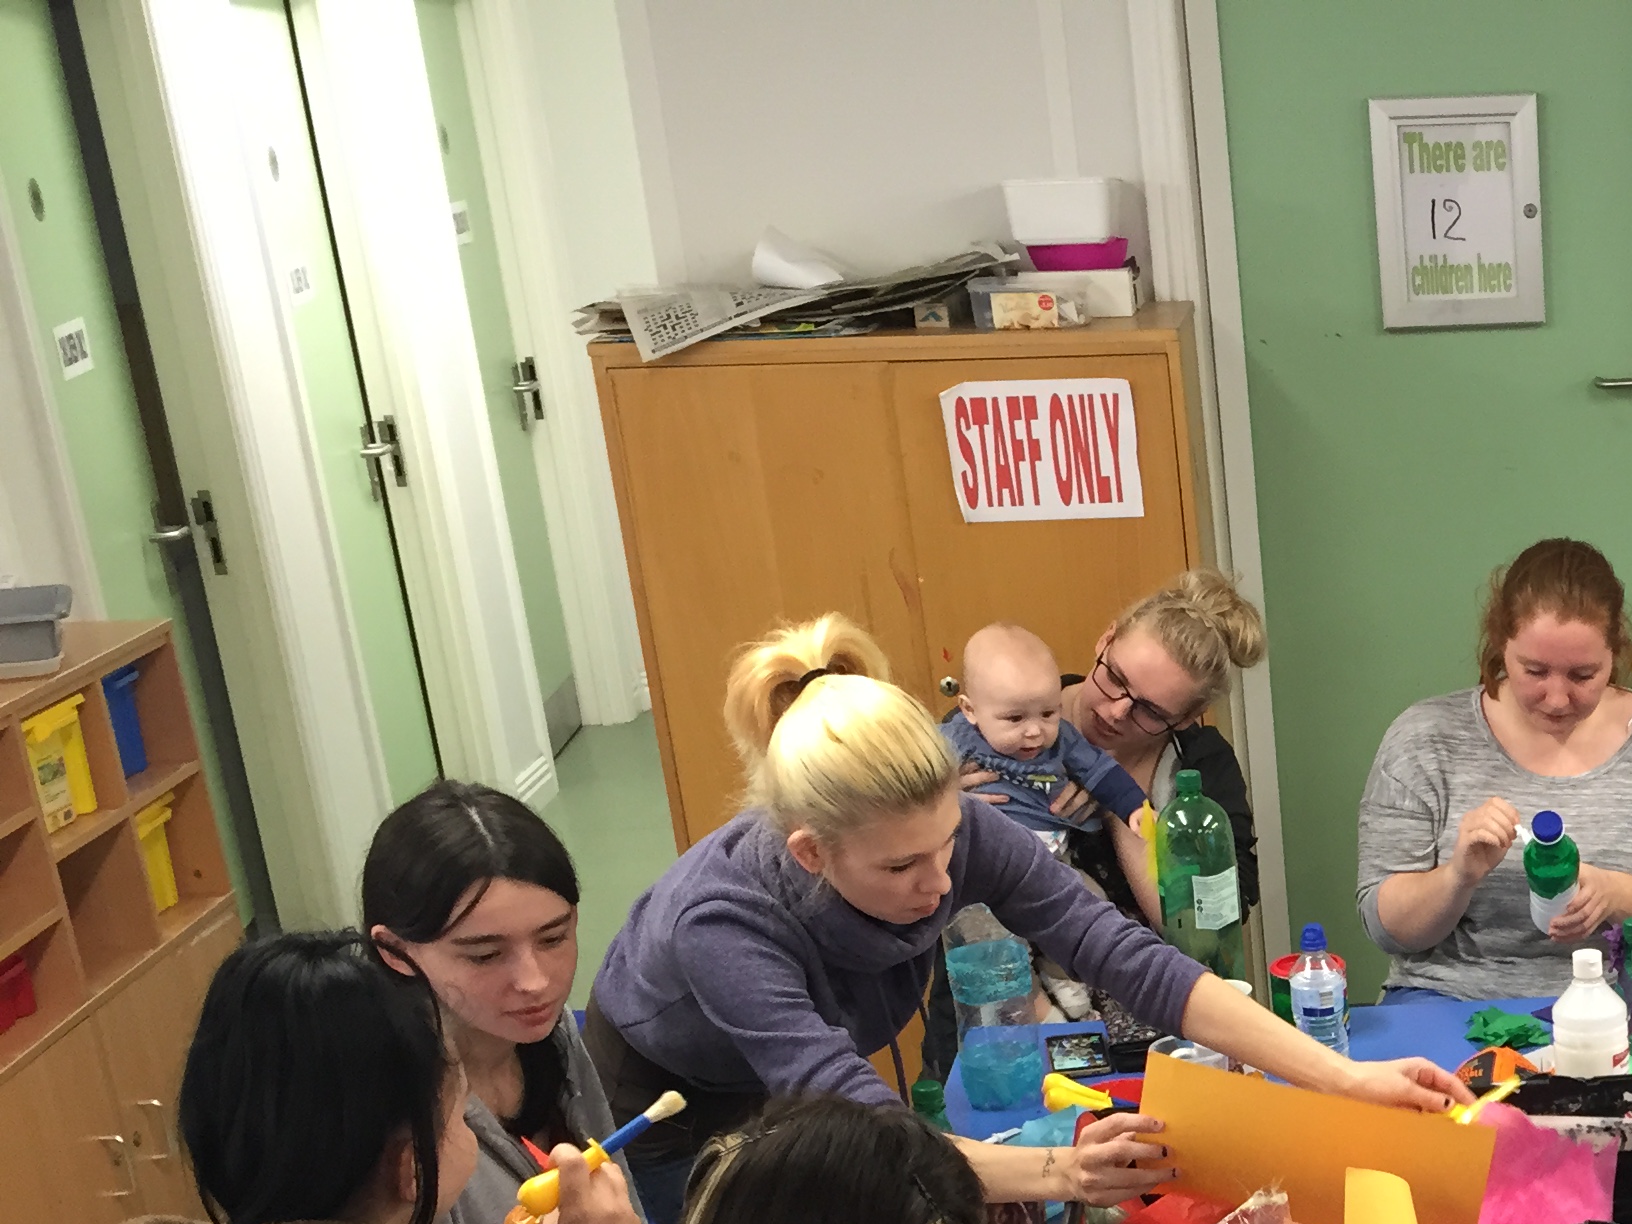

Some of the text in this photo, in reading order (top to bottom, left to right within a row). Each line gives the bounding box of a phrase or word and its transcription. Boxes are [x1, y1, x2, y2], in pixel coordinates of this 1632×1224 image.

[1403, 131, 1507, 174] There are
[1431, 198, 1466, 241] 12
[1411, 252, 1512, 296] children here
[955, 393, 1123, 510] STAFF ONLY
